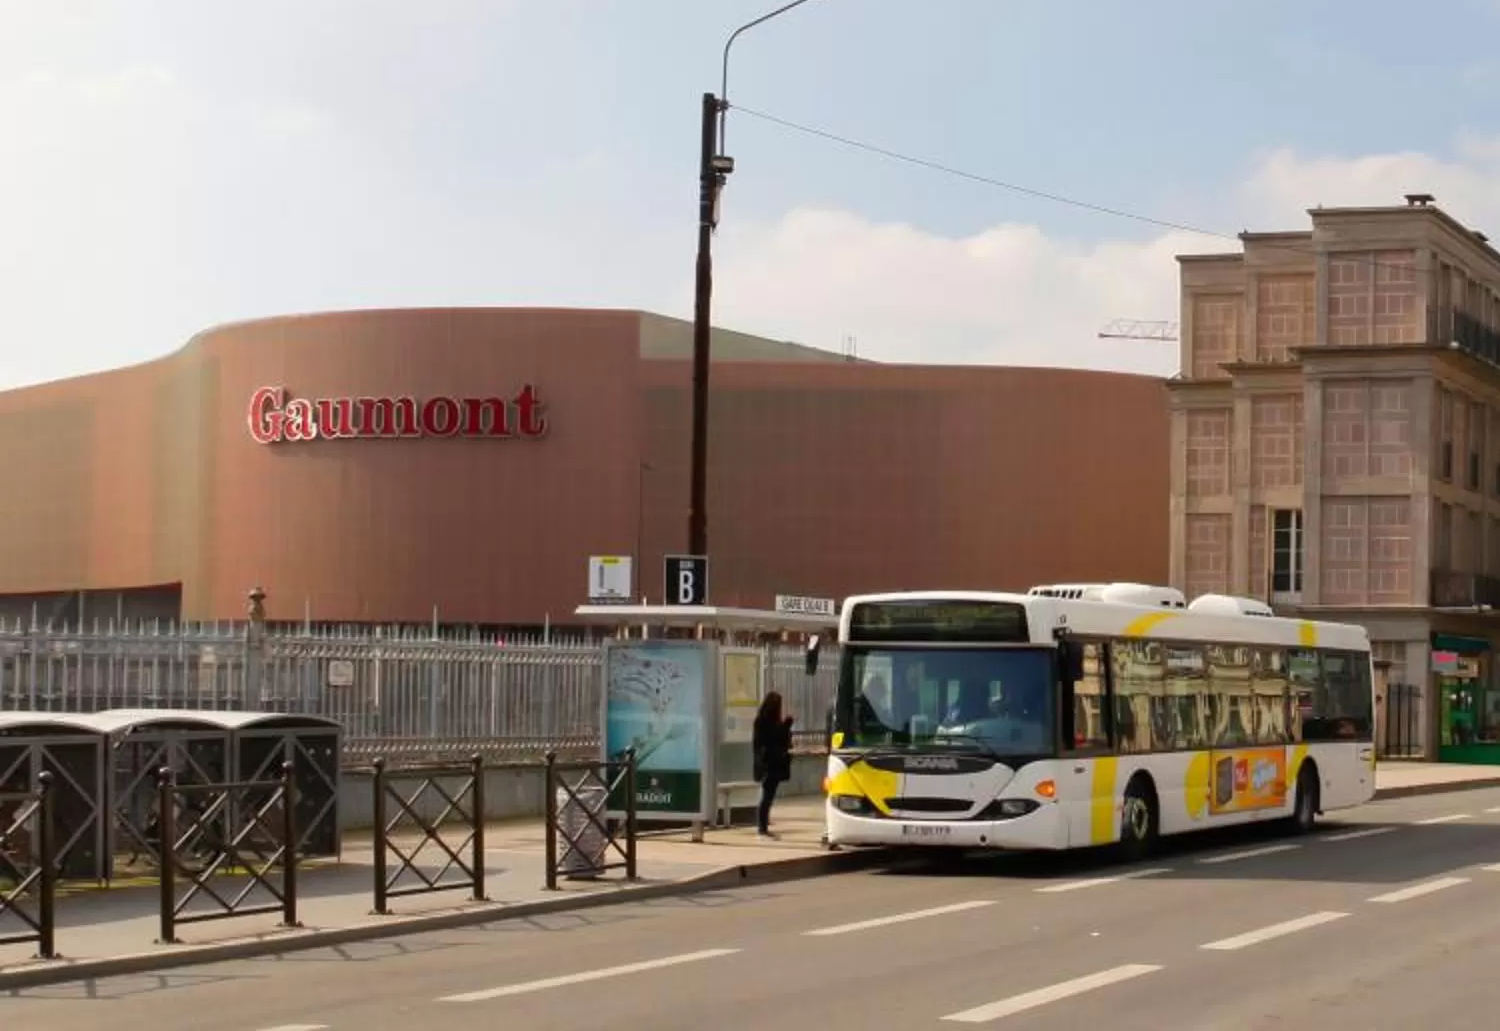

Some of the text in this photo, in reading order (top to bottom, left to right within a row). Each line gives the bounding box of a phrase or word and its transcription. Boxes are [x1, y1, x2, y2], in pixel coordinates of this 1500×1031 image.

[248, 383, 547, 444] Gaumont
[679, 570, 693, 603] B
[904, 757, 958, 769] SCANIA
